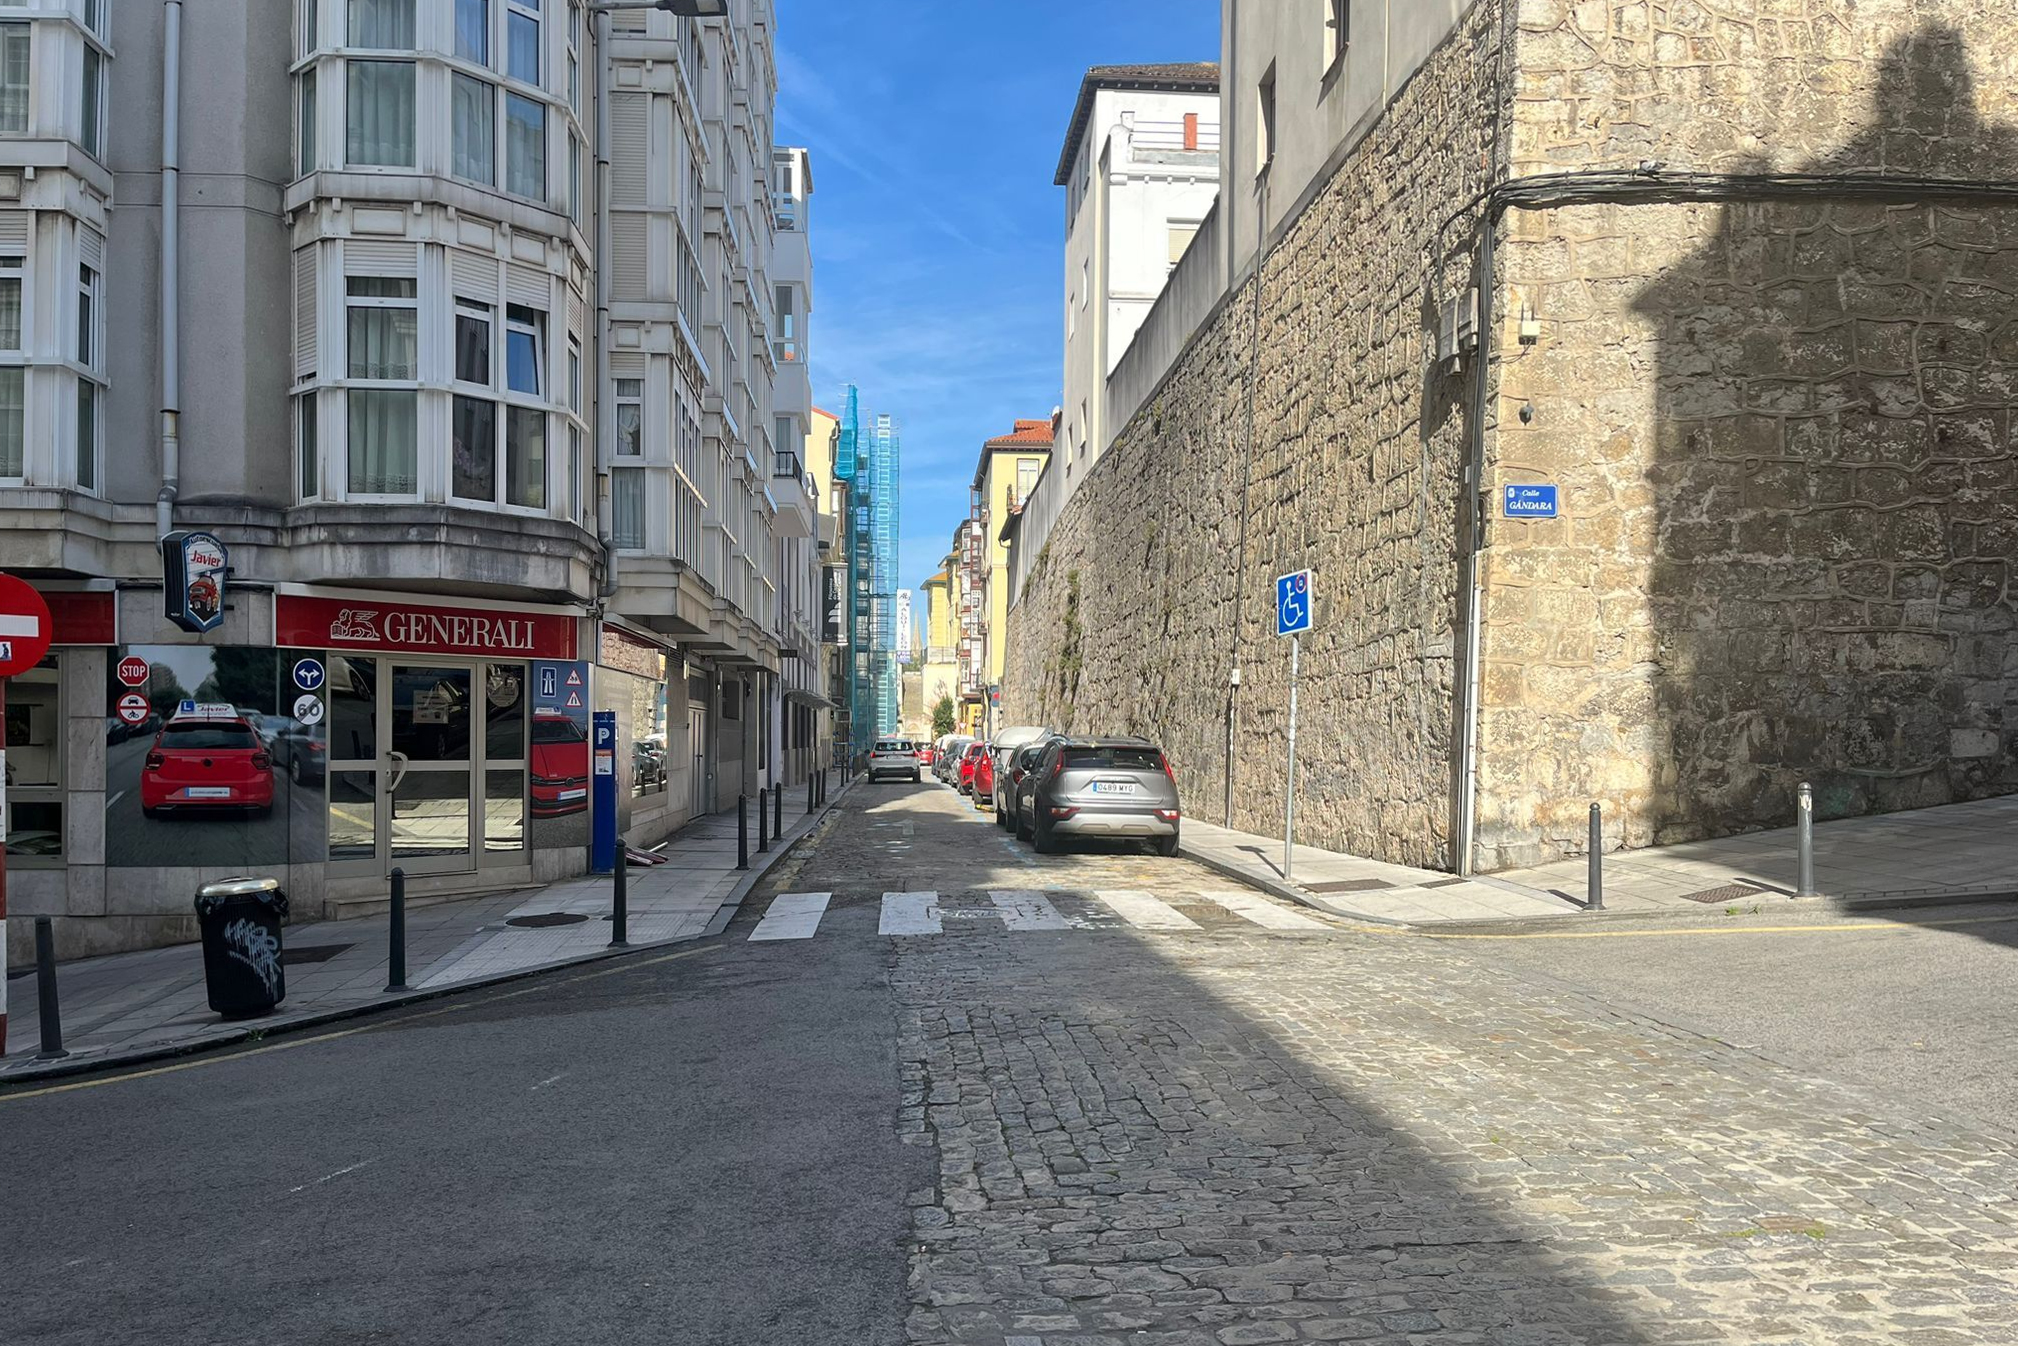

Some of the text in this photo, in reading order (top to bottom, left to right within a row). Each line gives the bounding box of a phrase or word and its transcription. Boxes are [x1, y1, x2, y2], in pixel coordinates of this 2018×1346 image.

[1510, 500, 1552, 510] GÁNDARA
[190, 550, 221, 567] Javier
[383, 612, 535, 650] GENERALI
[122, 665, 146, 677] STOP
[183, 702, 192, 711] L
[297, 703, 320, 717] 60
[598, 728, 610, 745] P
[1098, 783, 1117, 791] 0489
